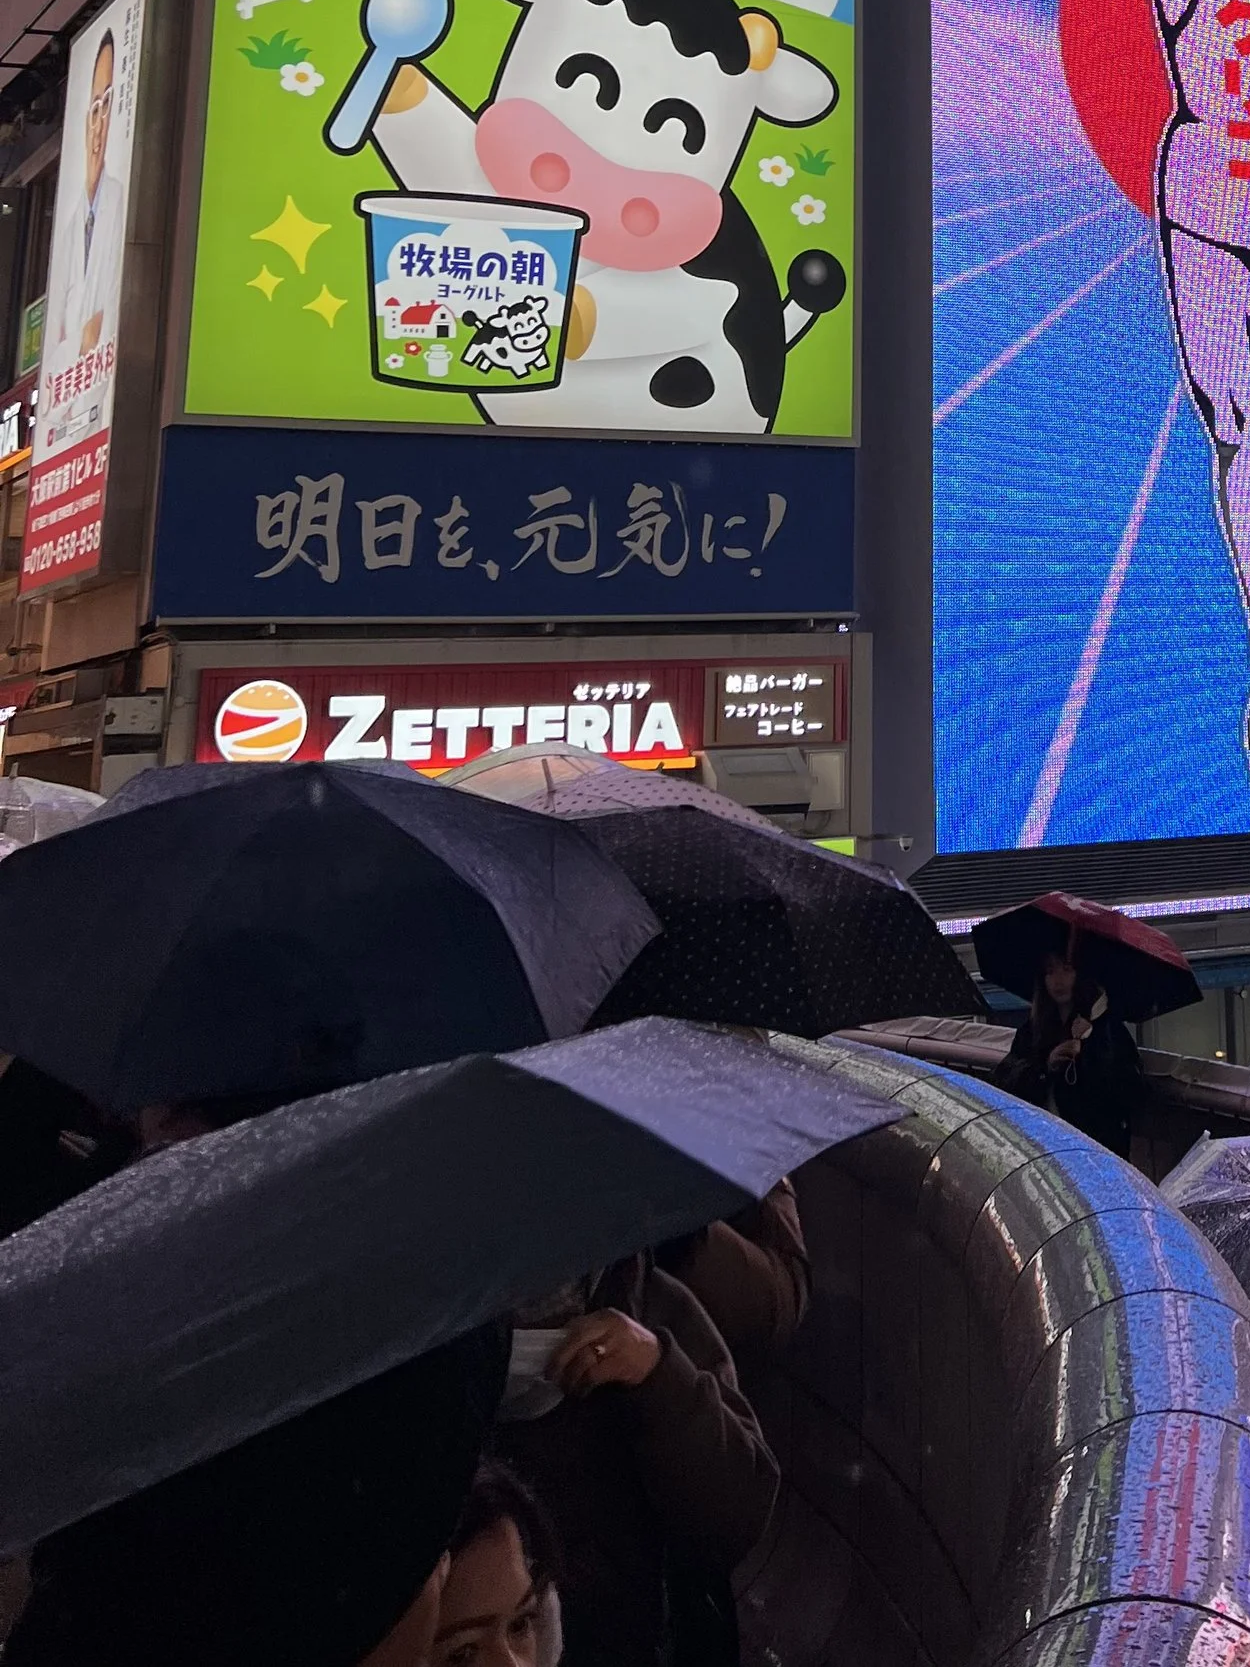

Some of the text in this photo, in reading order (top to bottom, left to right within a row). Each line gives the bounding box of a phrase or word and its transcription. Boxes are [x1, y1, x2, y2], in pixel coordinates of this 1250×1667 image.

[399, 242, 546, 286] 牧場の朝
[437, 283, 506, 302] ヨーグルト
[572, 682, 651, 702] ゼッテリア
[725, 672, 824, 694] 絶品バーガー
[724, 701, 804, 718] フェアトレード
[323, 694, 686, 761] ZETTERIA
[757, 717, 824, 736] コーヒー
